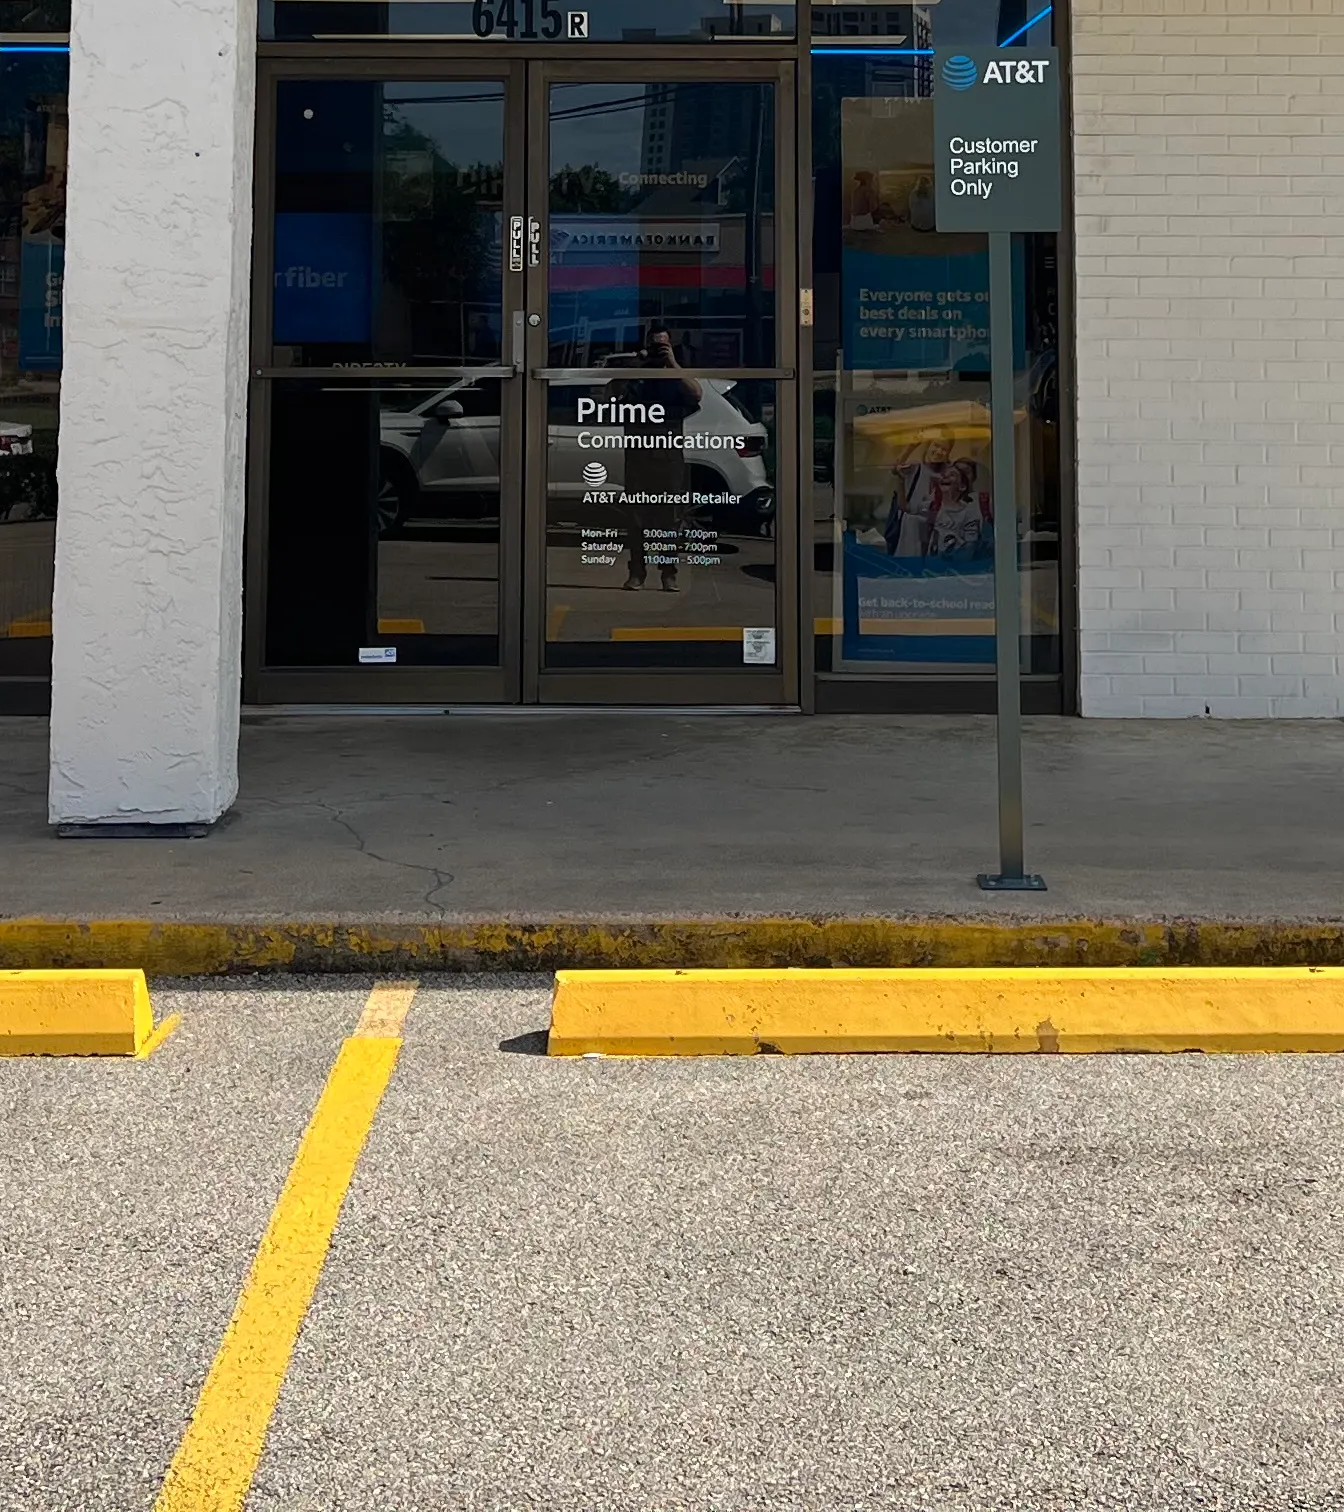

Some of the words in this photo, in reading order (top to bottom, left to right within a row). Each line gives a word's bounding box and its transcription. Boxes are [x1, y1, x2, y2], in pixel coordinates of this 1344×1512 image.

[570, 13, 585, 36] R
[982, 60, 1050, 84] AT&T
[949, 137, 1038, 154] Customer
[950, 157, 1019, 178] Parking
[618, 171, 708, 188] Connecting
[950, 178, 993, 199] Only
[285, 266, 349, 288] fiber
[859, 288, 933, 305] Everyone
[936, 290, 971, 305] gets
[859, 306, 894, 320] best
[898, 306, 939, 320] deals
[942, 309, 962, 320] on
[859, 326, 905, 341] every
[908, 325, 990, 341] smartpho
[577, 397, 666, 423] Prime
[577, 430, 746, 450] Communications
[582, 492, 616, 504] AT&T
[619, 491, 690, 504] Authorized
[692, 491, 742, 505] Retailer
[581, 529, 618, 538] Mon-Fri
[581, 542, 624, 553] Saturday
[581, 555, 616, 566] Sunday
[881, 597, 967, 609] back-to-school
[970, 600, 995, 610] read
